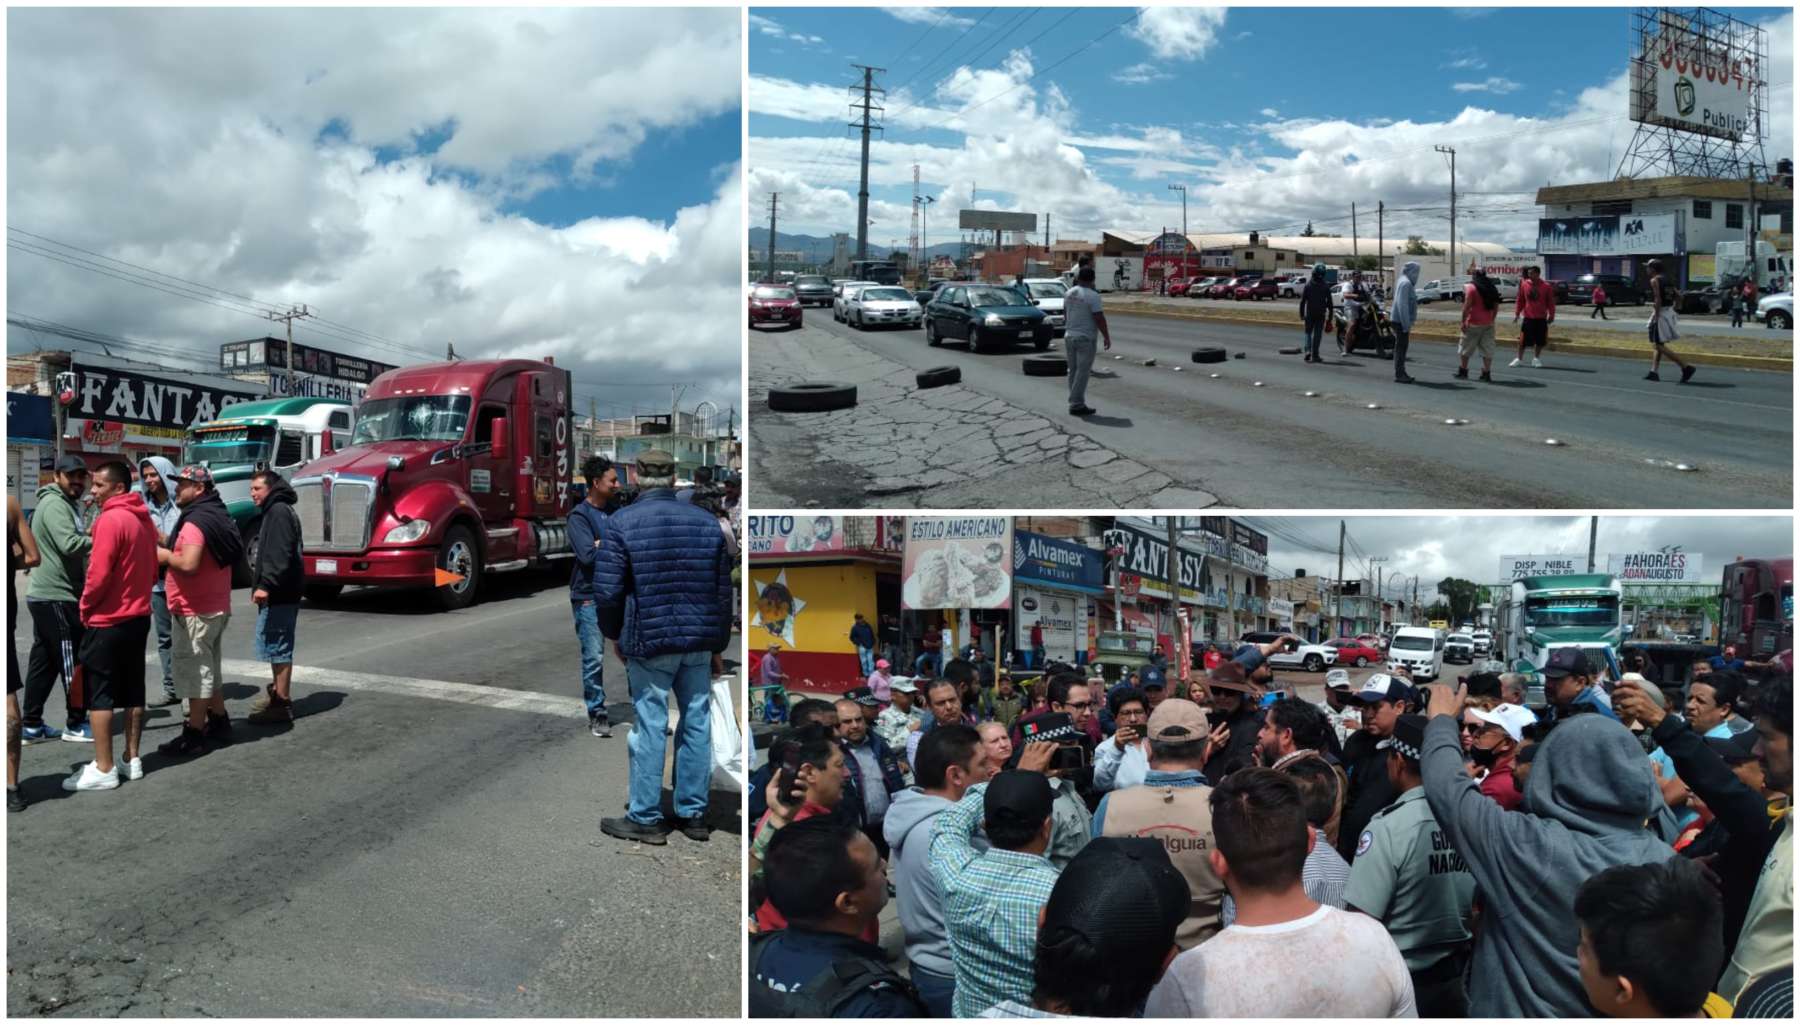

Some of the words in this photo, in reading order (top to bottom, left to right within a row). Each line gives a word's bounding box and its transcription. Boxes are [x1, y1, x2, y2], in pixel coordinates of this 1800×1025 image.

[80, 371, 263, 426] FANTA
[912, 520, 944, 538] ESTILO
[946, 518, 1006, 537] AMERICANO
[748, 540, 772, 552] ANO
[1027, 538, 1083, 567] Alvamex
[1624, 554, 1685, 568] #AHORAES
